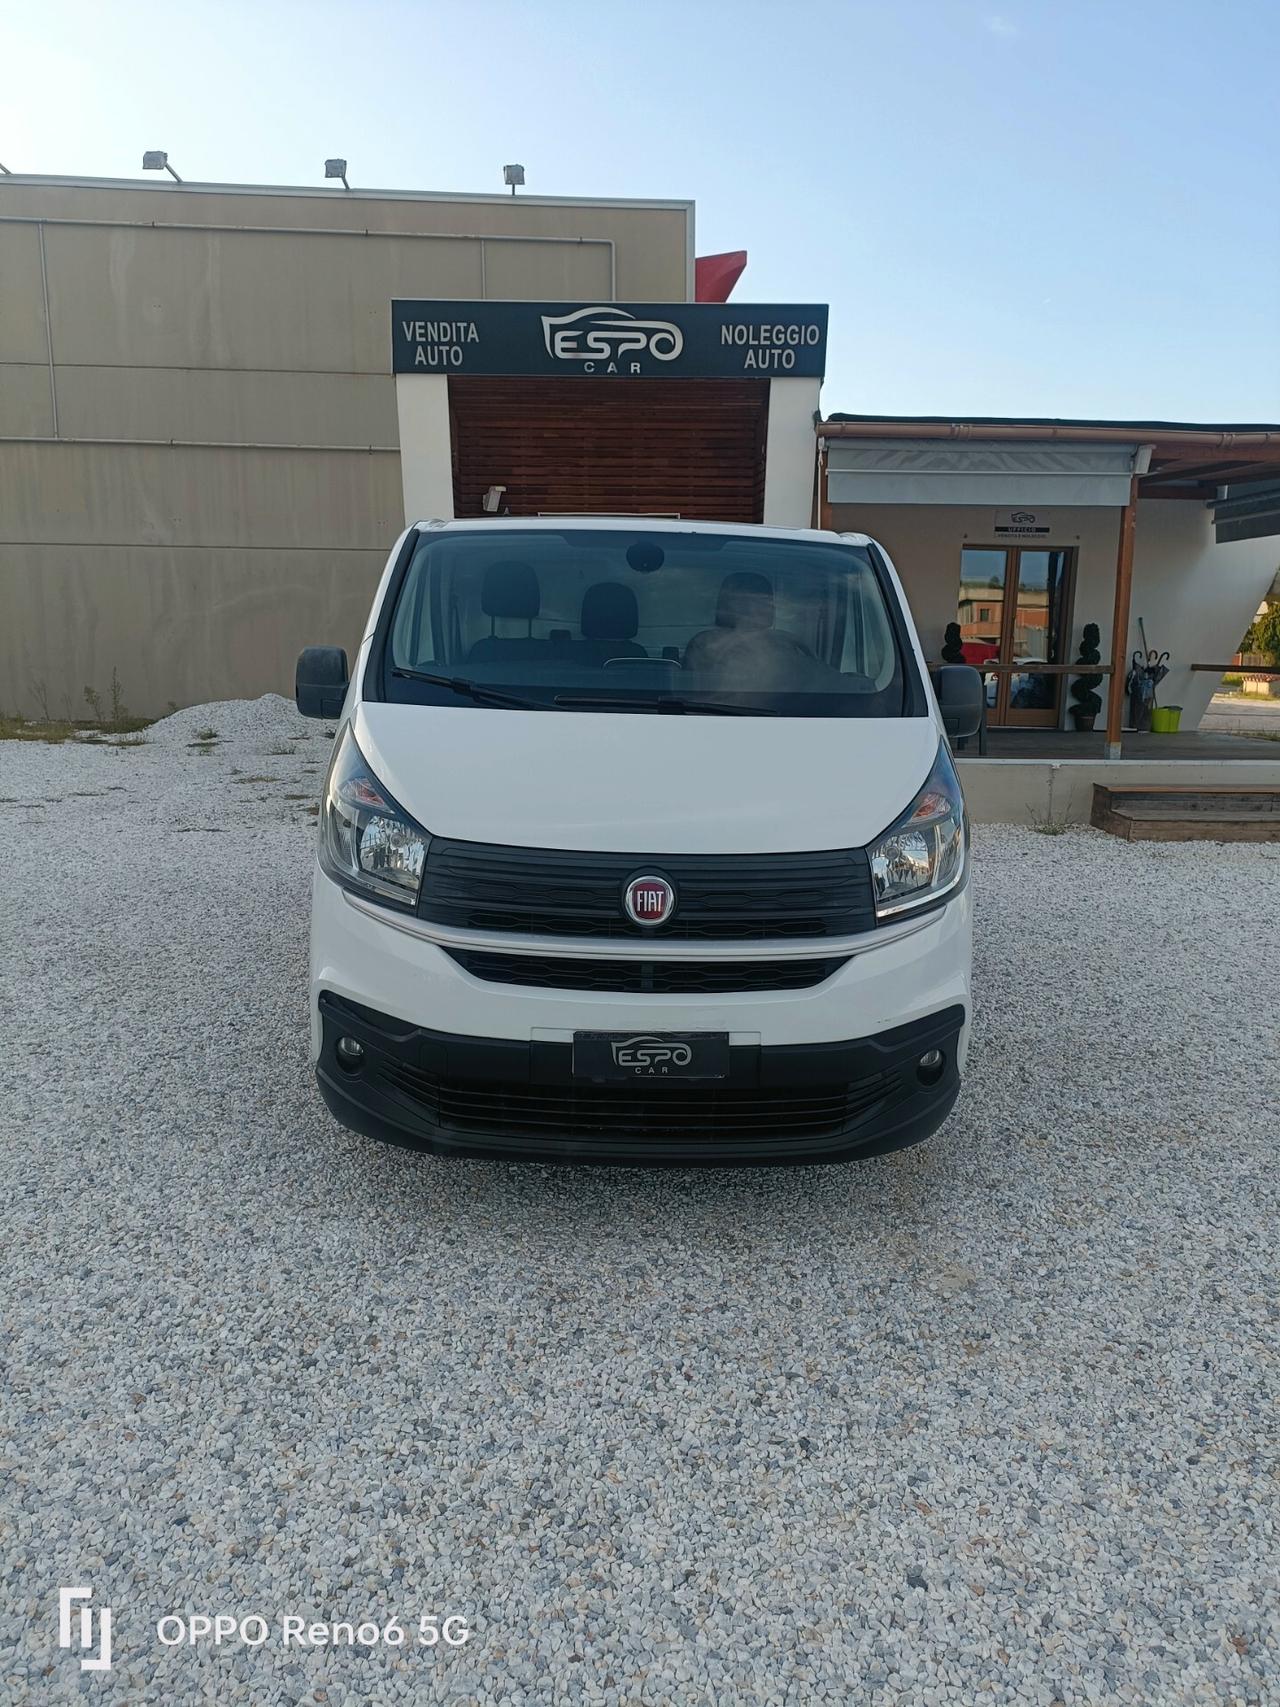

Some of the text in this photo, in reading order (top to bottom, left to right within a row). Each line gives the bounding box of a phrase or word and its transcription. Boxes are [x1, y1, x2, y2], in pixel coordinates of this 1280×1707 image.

[402, 320, 480, 343] VENDITA
[550, 318, 684, 361] ESPO
[721, 324, 820, 346] NOLEGGIO
[414, 346, 464, 366] AUTO
[744, 349, 796, 369] AUTO
[584, 361, 641, 374] CAR
[636, 890, 665, 912] FIAT
[616, 1041, 692, 1066] ESPO
[634, 1066, 668, 1074] CAR
